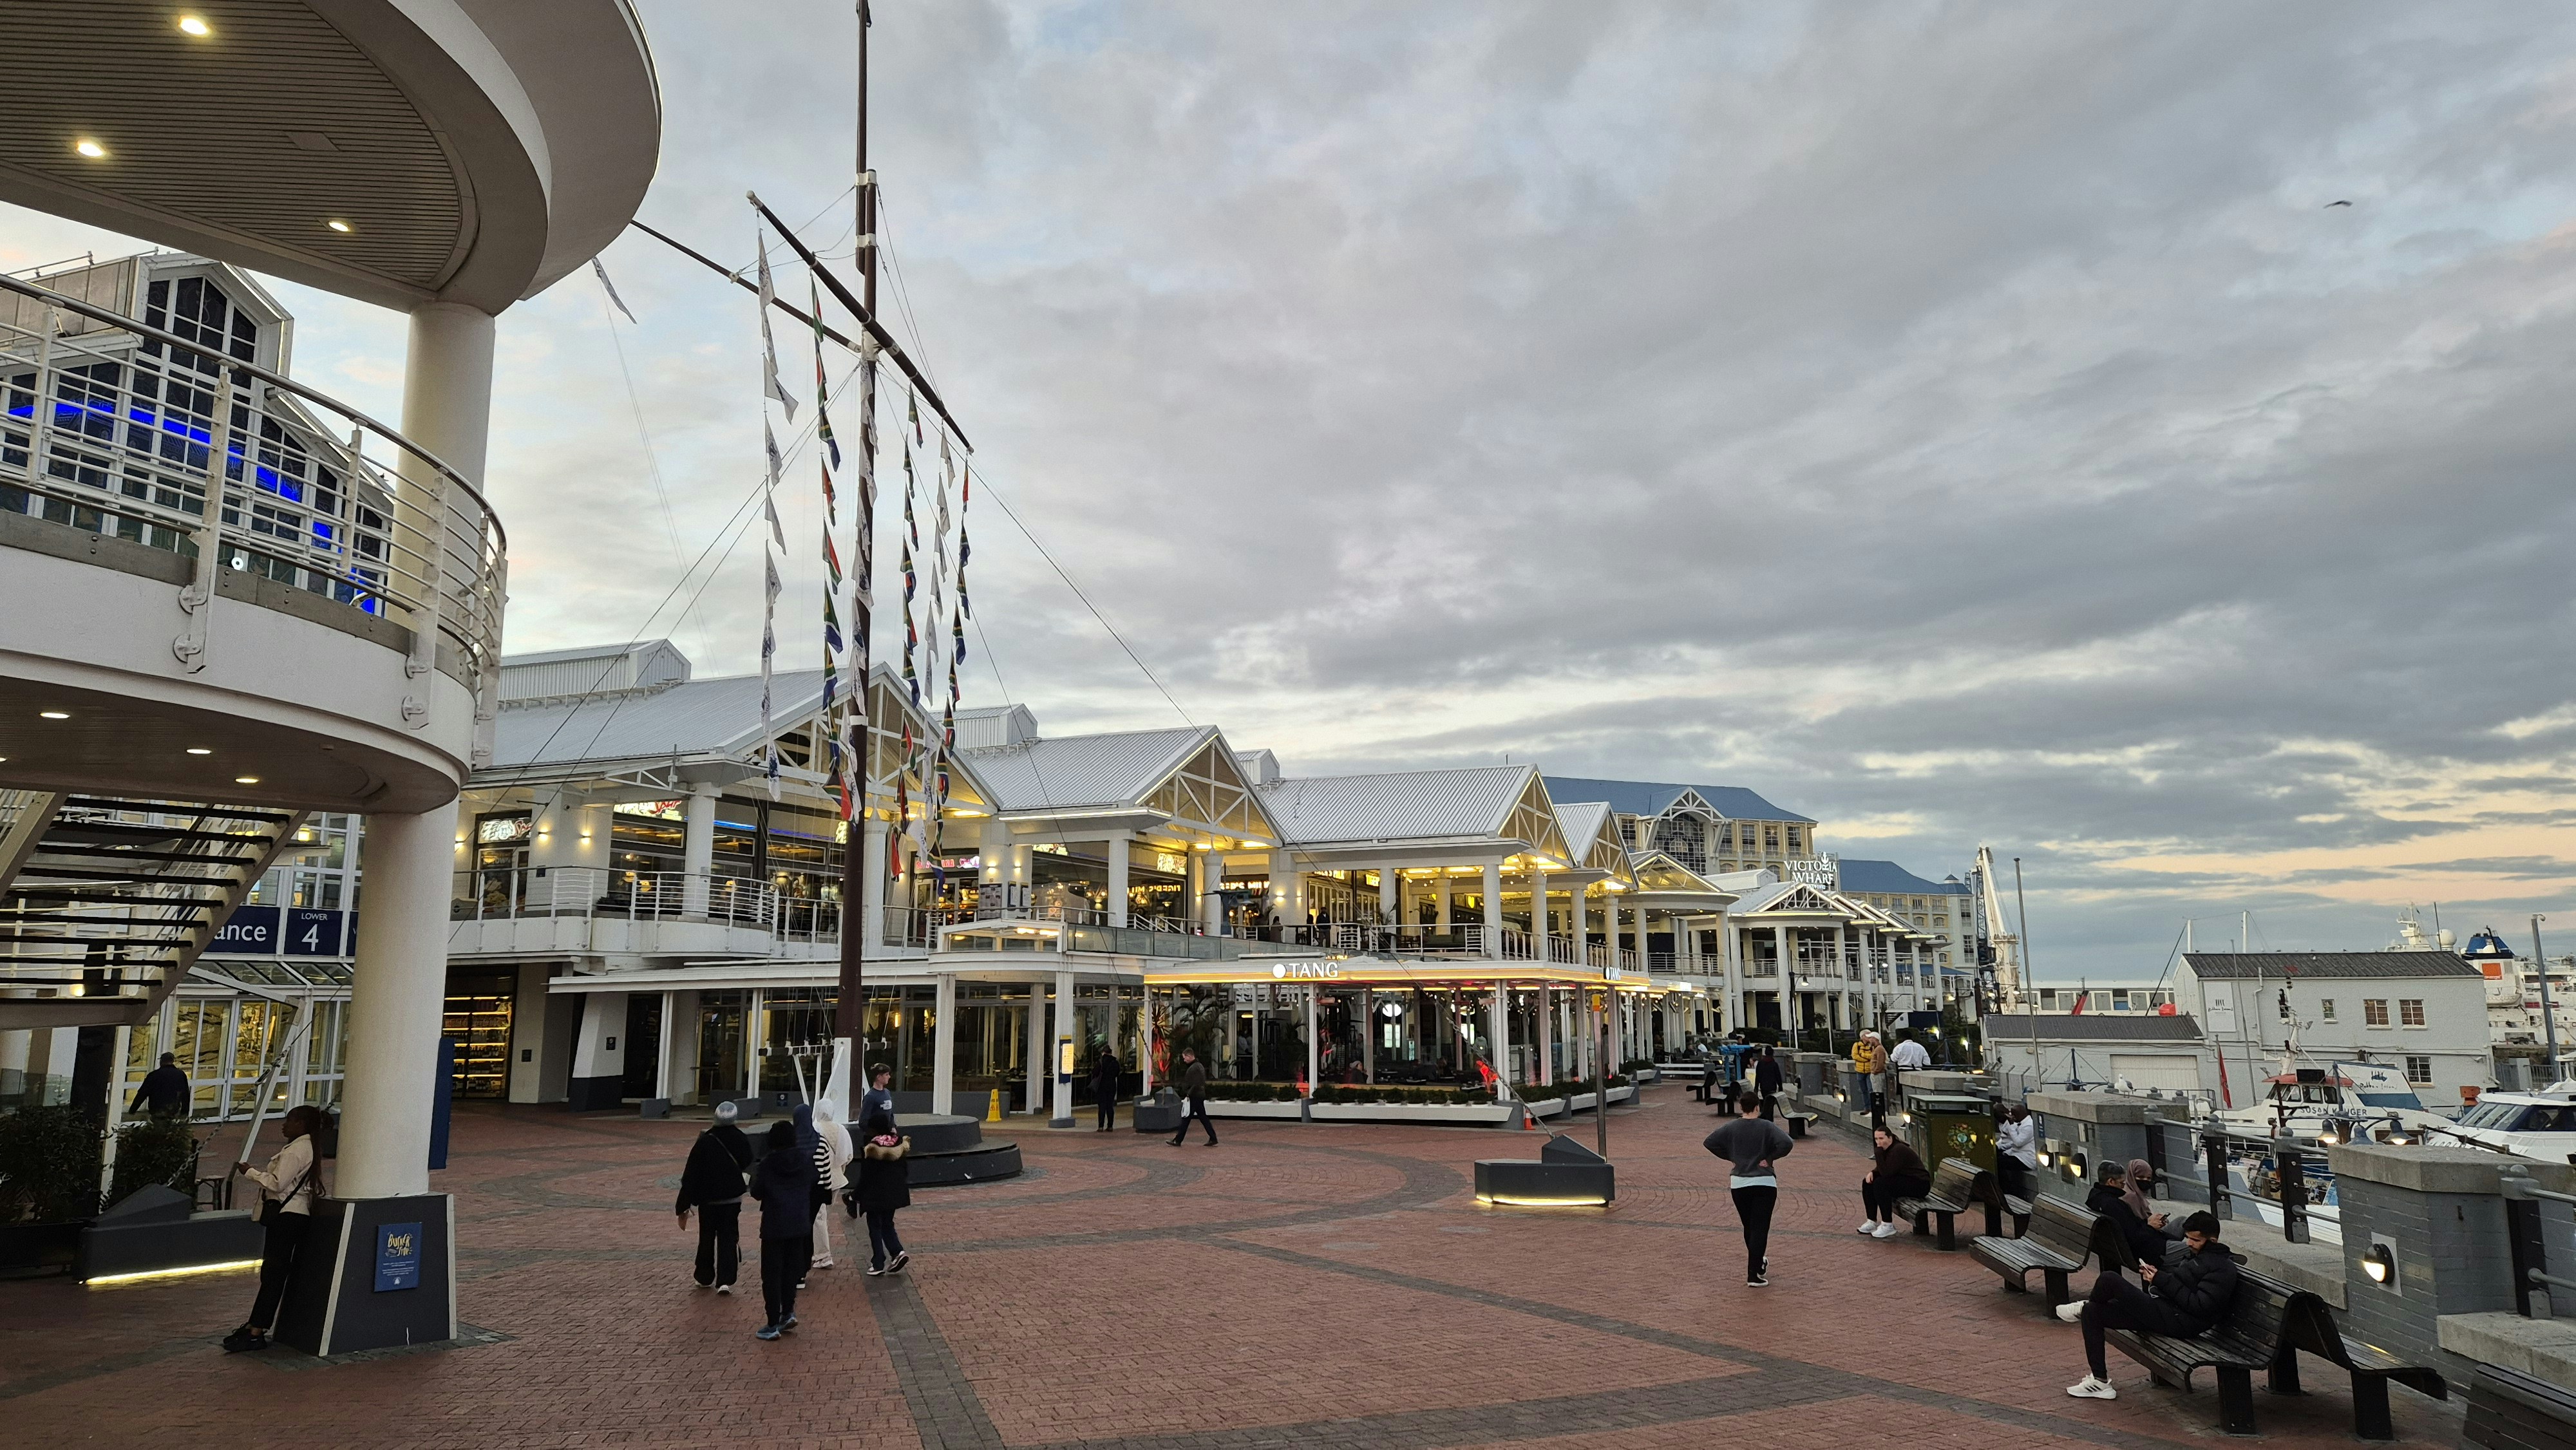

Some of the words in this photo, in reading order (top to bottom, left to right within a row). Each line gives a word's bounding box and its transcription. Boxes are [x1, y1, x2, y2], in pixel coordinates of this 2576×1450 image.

[1784, 860, 1837, 872] VICTORIA
[1792, 872, 1833, 884] WHARF
[301, 912, 327, 921] LOWER
[214, 925, 267, 942] ance
[301, 923, 319, 952] 4
[1289, 962, 1338, 978] TANG
[2332, 1107, 2367, 1116] KUGER
